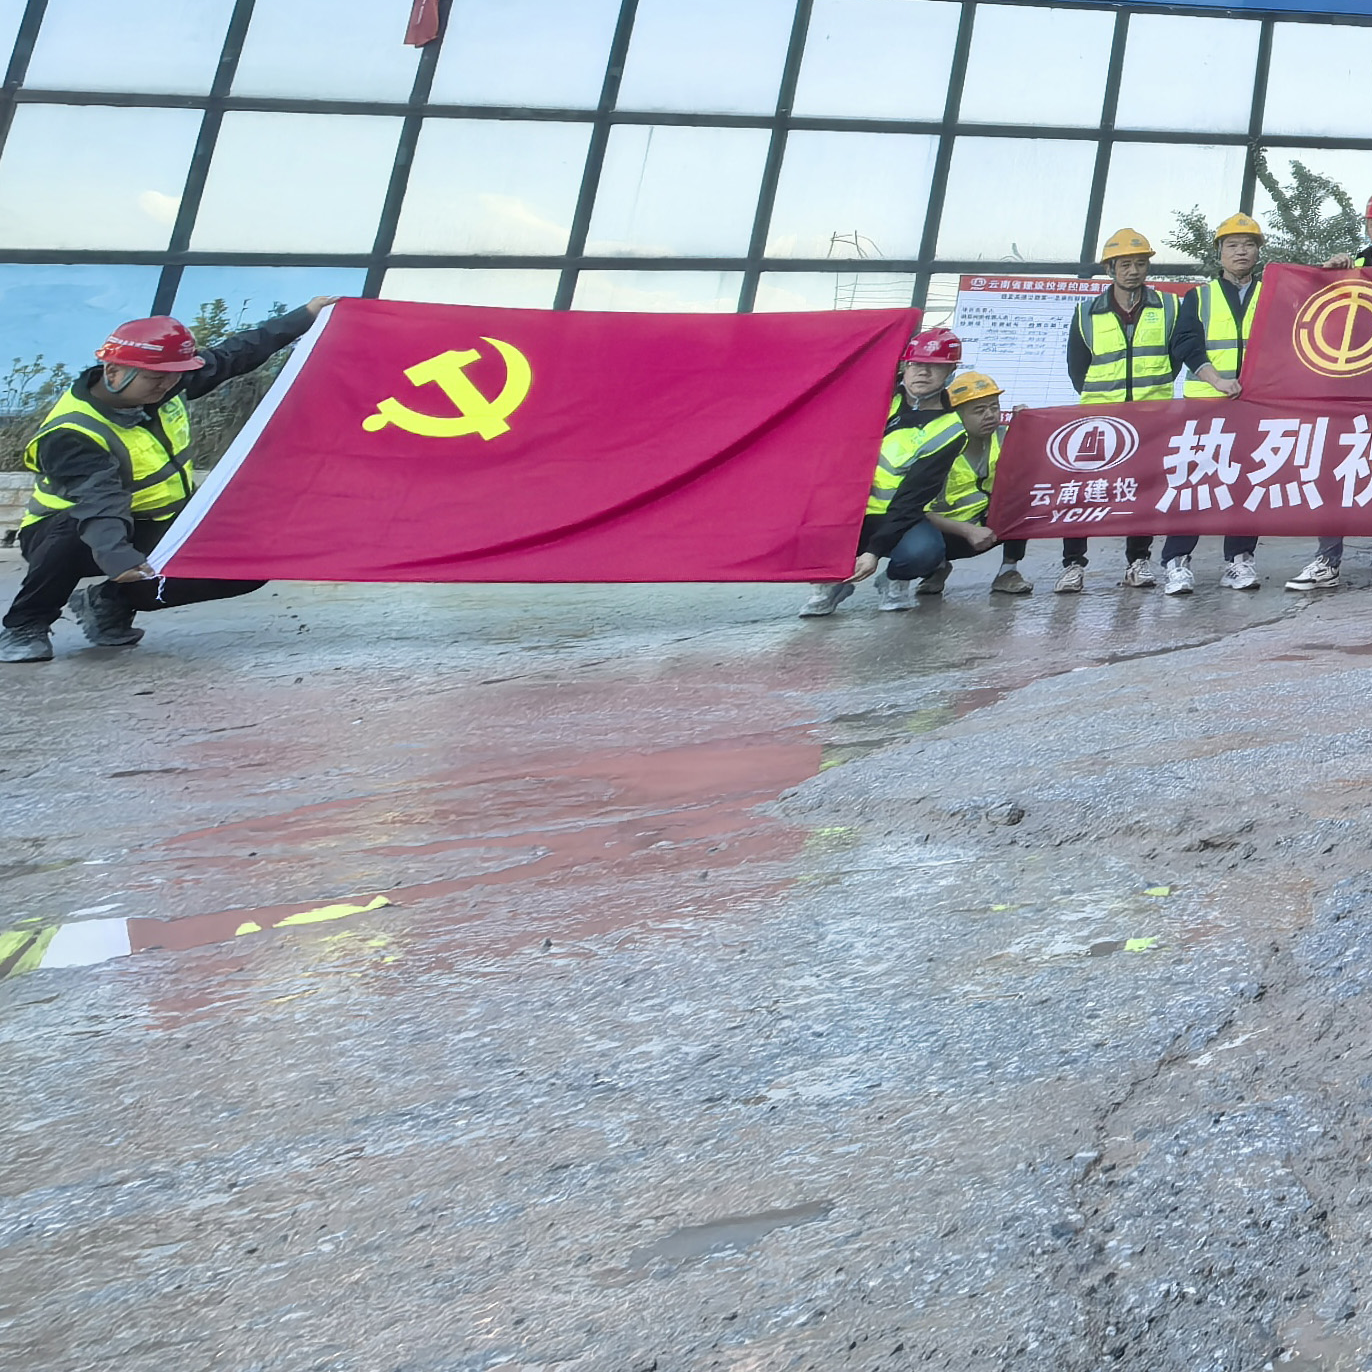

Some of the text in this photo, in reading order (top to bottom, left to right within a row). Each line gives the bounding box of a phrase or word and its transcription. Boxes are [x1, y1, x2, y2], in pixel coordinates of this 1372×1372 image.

[1030, 477, 1138, 507] 云南建投
[1049, 507, 1112, 523] YCIH
